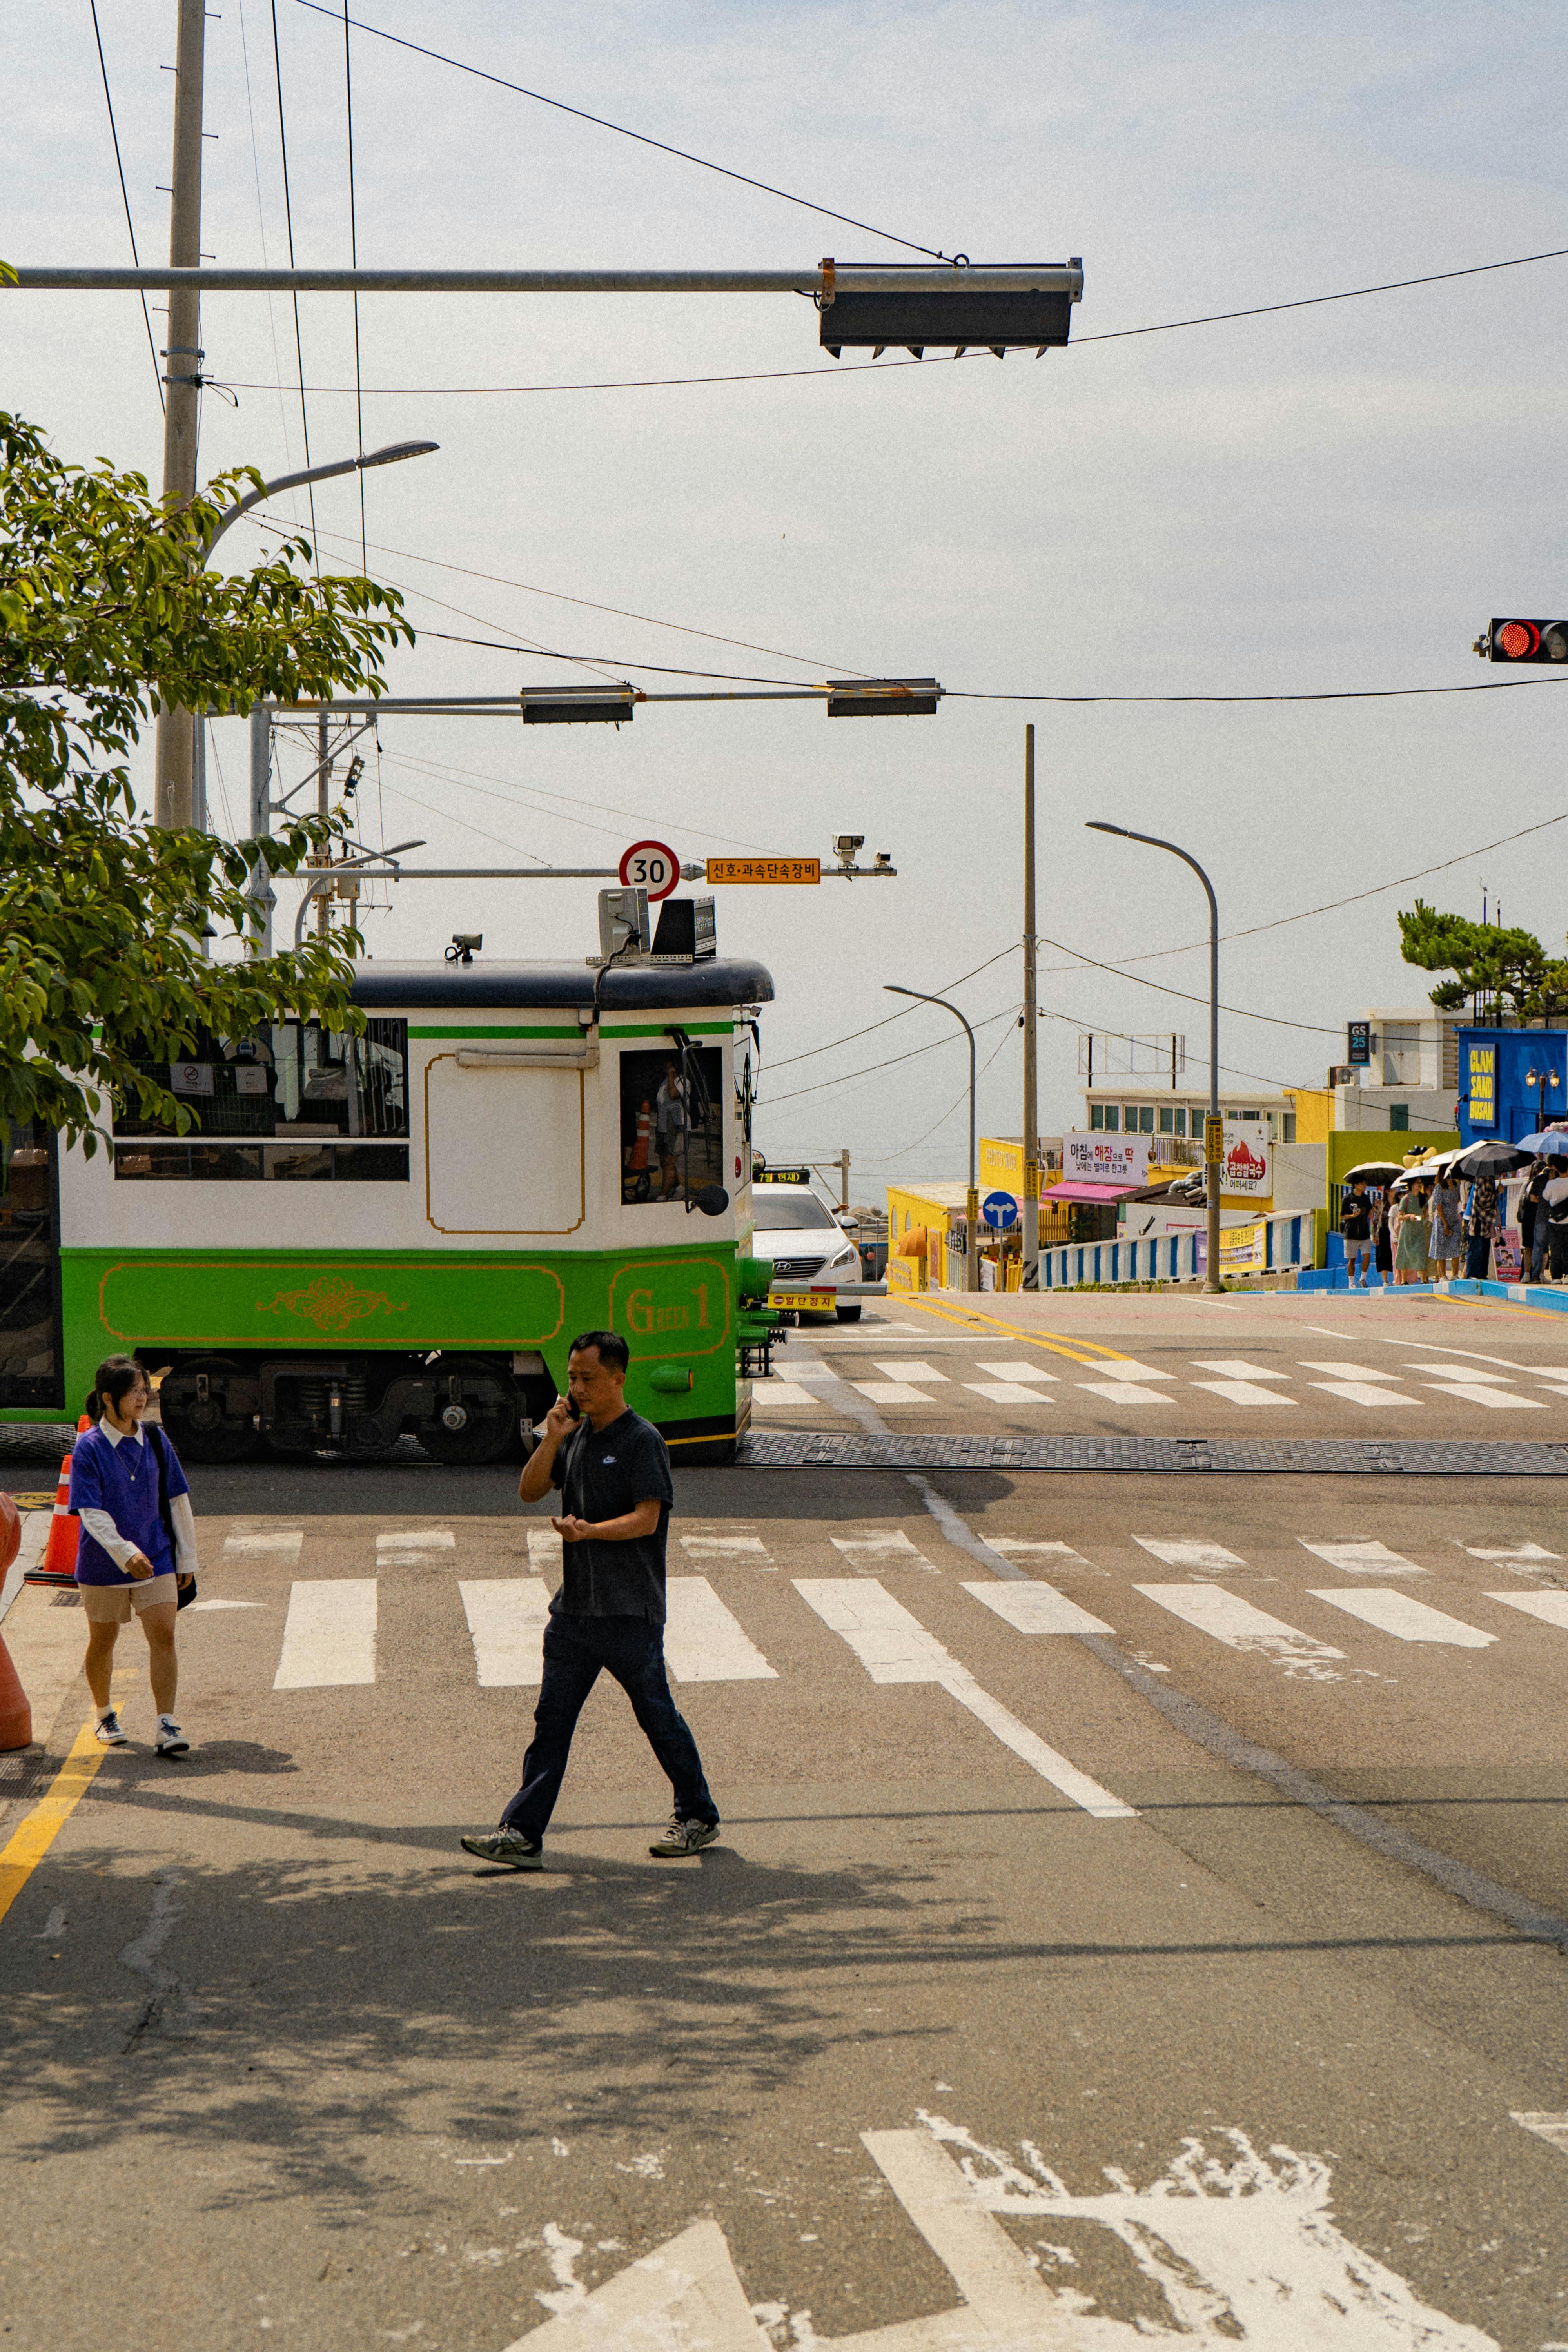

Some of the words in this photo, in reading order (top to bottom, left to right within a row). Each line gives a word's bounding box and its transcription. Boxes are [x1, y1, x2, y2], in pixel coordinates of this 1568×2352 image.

[634, 860, 664, 883] 30
[713, 864, 815, 878] 신호·과속단속장비
[1352, 1025, 1366, 1036] GS
[1352, 1037, 1366, 1048] 25
[1470, 1050, 1493, 1073] CLAM
[1471, 1076, 1492, 1098] SAND
[1470, 1100, 1493, 1120] BUSAN
[1071, 1143, 1093, 1160] 아침에
[1095, 1145, 1123, 1162] 해장으로
[1125, 1147, 1134, 1163] 딱
[1076, 1162, 1091, 1171] 낮에는
[1094, 1163, 1109, 1172] 별미로
[1112, 1163, 1127, 1174] 한그릇
[1229, 1162, 1262, 1178] 곱창쌀국수
[778, 1172, 800, 1182] 현재)
[691, 1283, 712, 1330] 1
[786, 1297, 830, 1307] 일단정지
